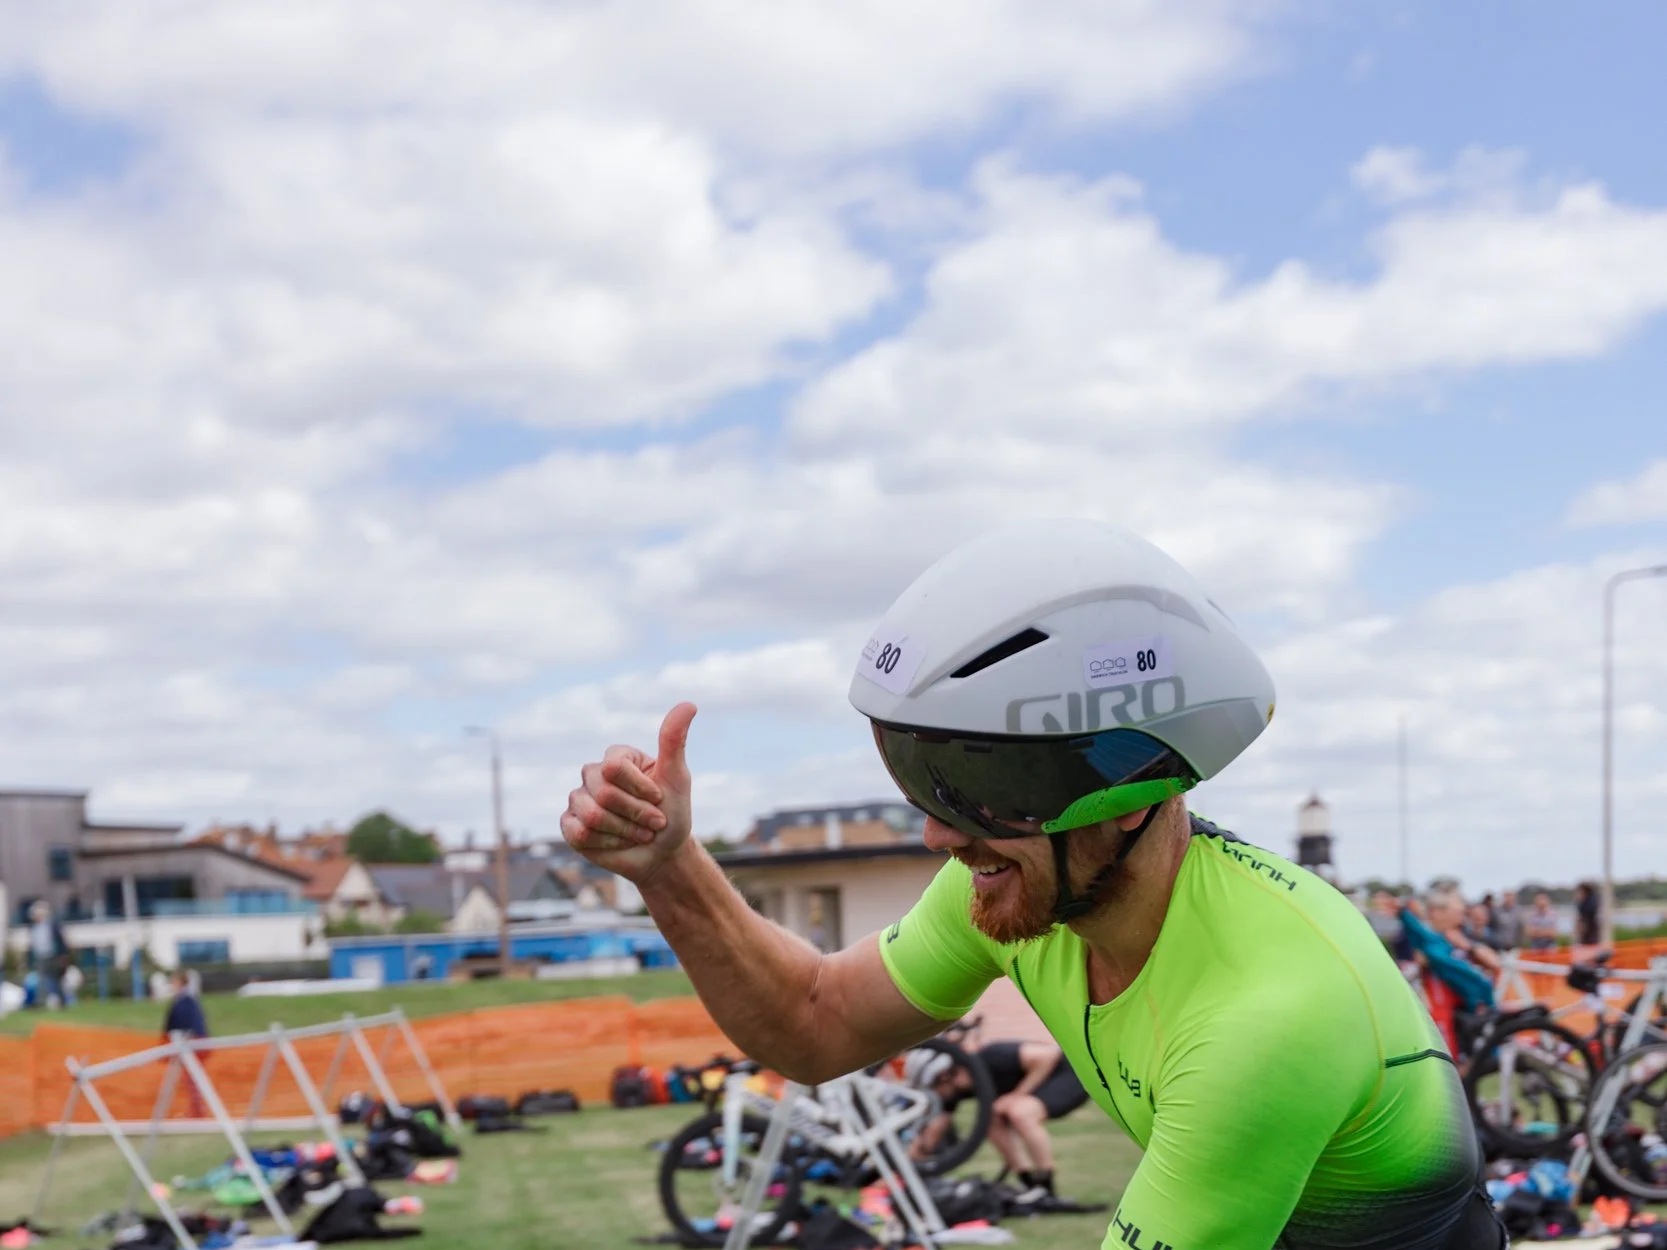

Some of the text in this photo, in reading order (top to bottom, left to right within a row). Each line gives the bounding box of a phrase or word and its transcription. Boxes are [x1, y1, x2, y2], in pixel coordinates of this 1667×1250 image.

[875, 642, 902, 675] 80
[1136, 648, 1157, 672] 80
[1006, 675, 1186, 733] GIRO
